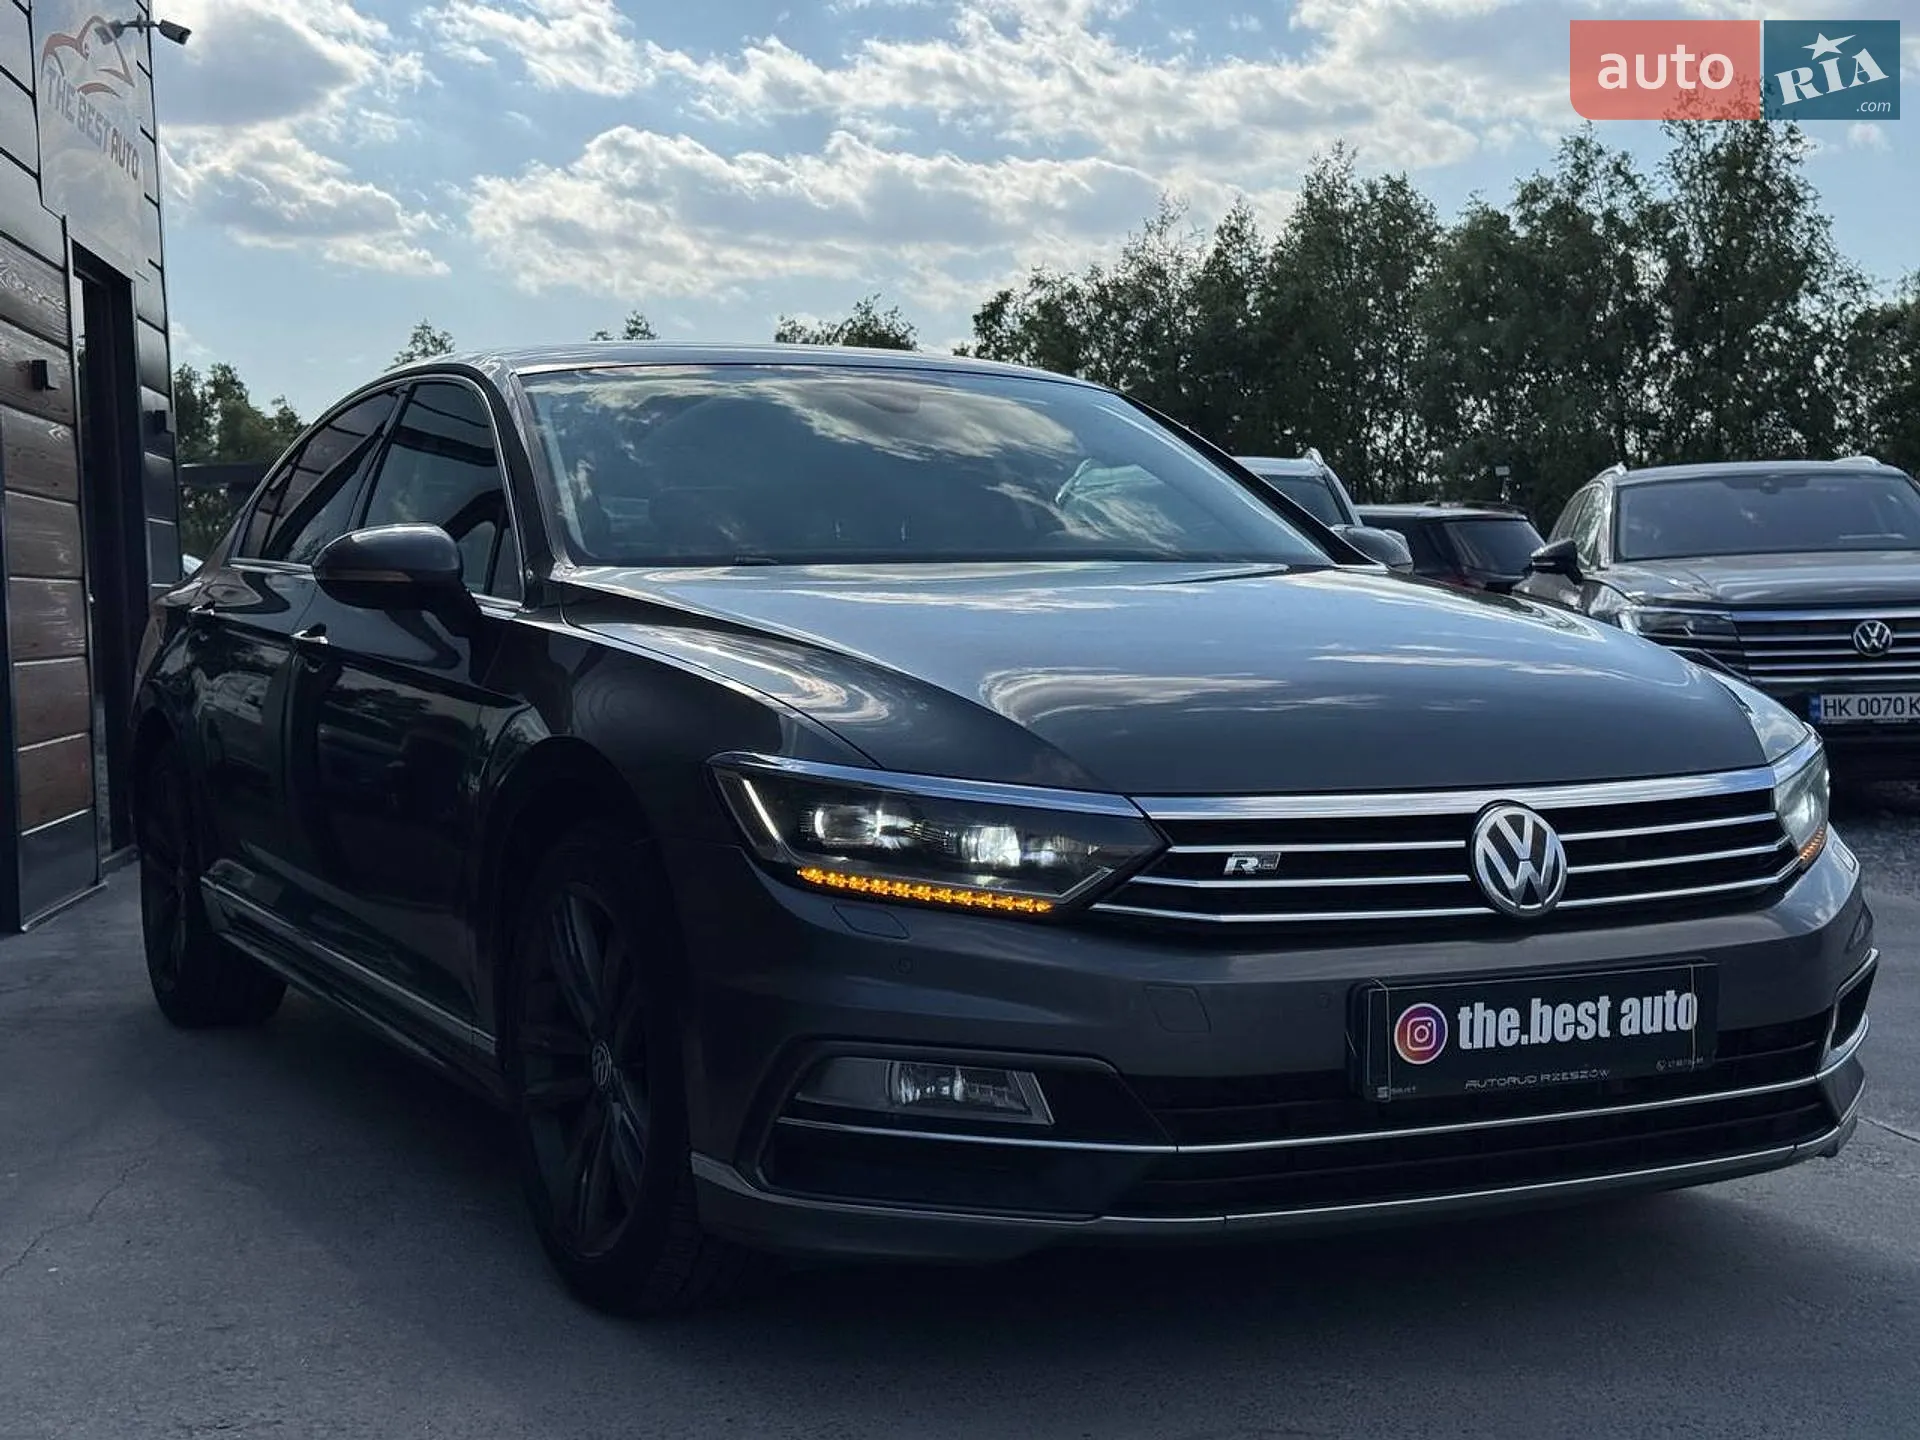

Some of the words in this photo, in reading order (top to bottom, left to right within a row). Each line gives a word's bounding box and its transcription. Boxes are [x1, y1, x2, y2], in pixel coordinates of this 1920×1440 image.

[47, 67, 75, 123] THE
[77, 94, 111, 153] BEST
[110, 127, 140, 181] AUTO
[1823, 698, 1852, 717] HK
[1858, 696, 1905, 716] 0070
[1458, 996, 1611, 1050] the.best
[1620, 989, 1697, 1036] auto
